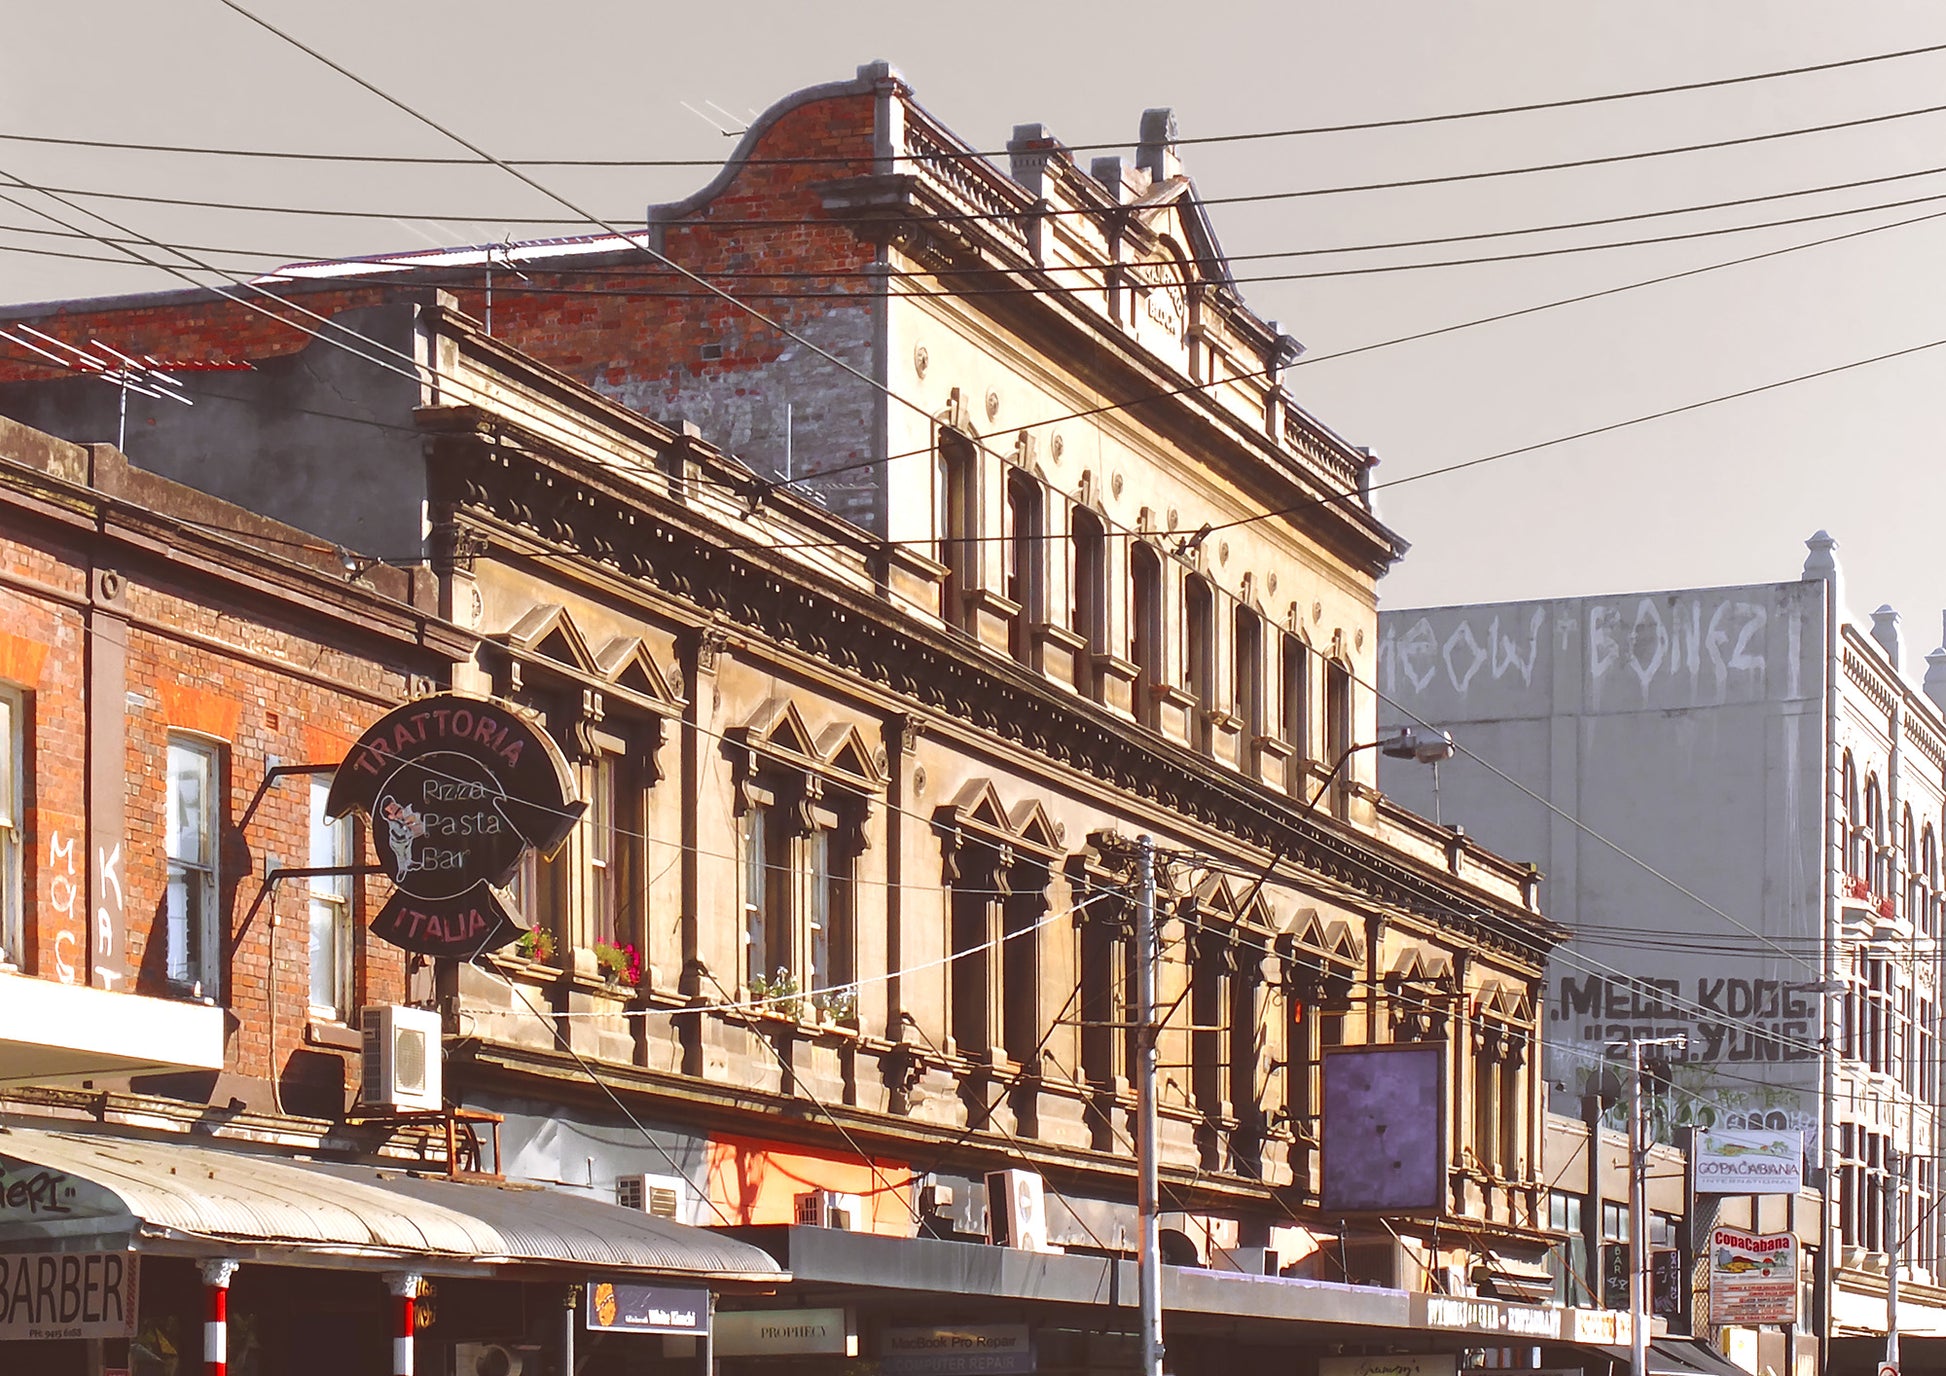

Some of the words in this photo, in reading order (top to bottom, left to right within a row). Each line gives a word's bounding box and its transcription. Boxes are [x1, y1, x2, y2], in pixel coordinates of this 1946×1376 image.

[354, 709, 525, 776] TRATTORIA
[422, 812, 501, 837] Pasta
[421, 847, 471, 871] Bar
[393, 908, 489, 943] ITALIA
[1613, 1245, 1622, 1274] BAR
[760, 1325, 827, 1339] PROPHECY
[891, 1335, 947, 1350] MacBook
[951, 1335, 973, 1349] Pro
[976, 1335, 1017, 1350] Repair
[895, 1357, 965, 1371] COMPUTER
[969, 1356, 1015, 1370] REPAIR
